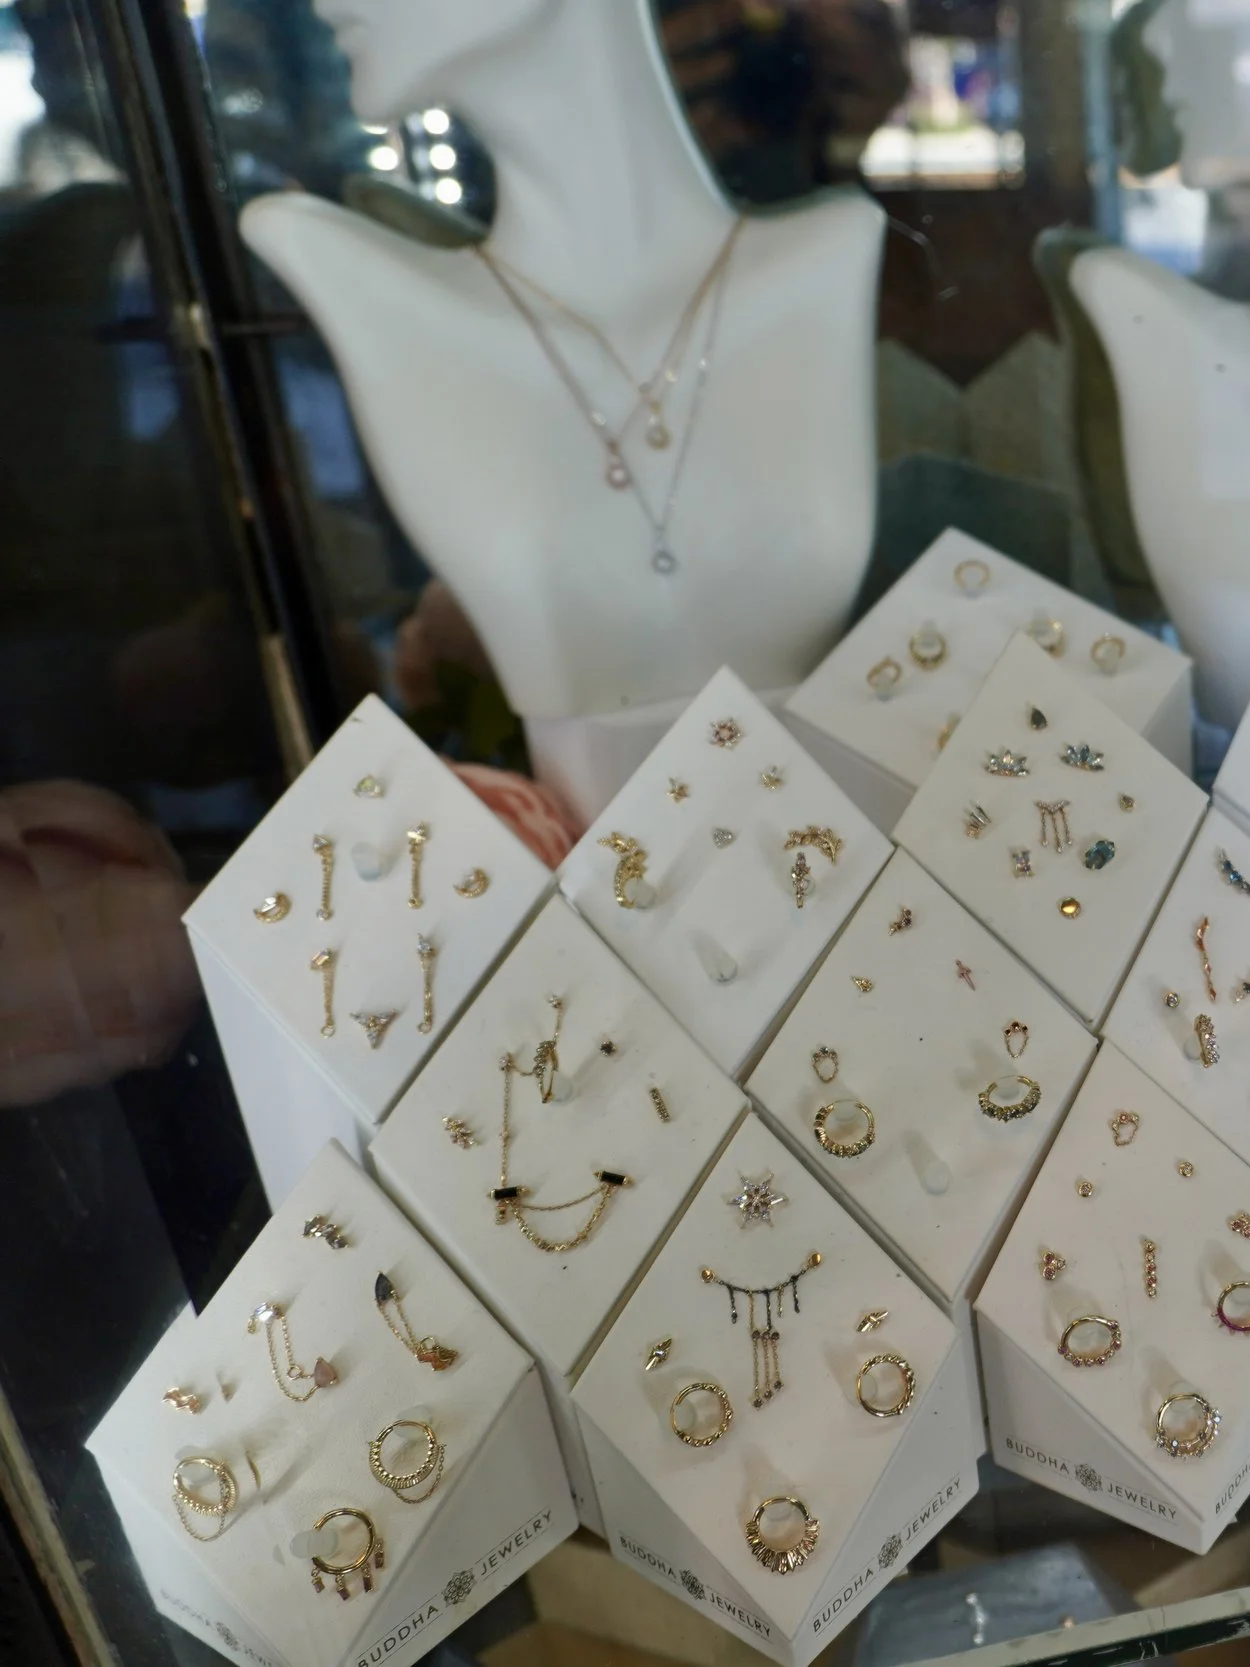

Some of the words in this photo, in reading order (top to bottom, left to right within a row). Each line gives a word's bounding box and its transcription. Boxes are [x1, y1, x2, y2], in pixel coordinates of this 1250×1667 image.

[1005, 1437, 1071, 1476] BUDDHA
[1107, 1482, 1178, 1520] JEWELRY
[357, 1604, 440, 1667] BUDDHA
[480, 1509, 553, 1576] JEWELRY
[619, 1535, 677, 1579] BUDDHA
[709, 1592, 771, 1638] JEWELRY
[812, 1567, 875, 1633] BUDDHA
[905, 1477, 962, 1541] JEWELRY
